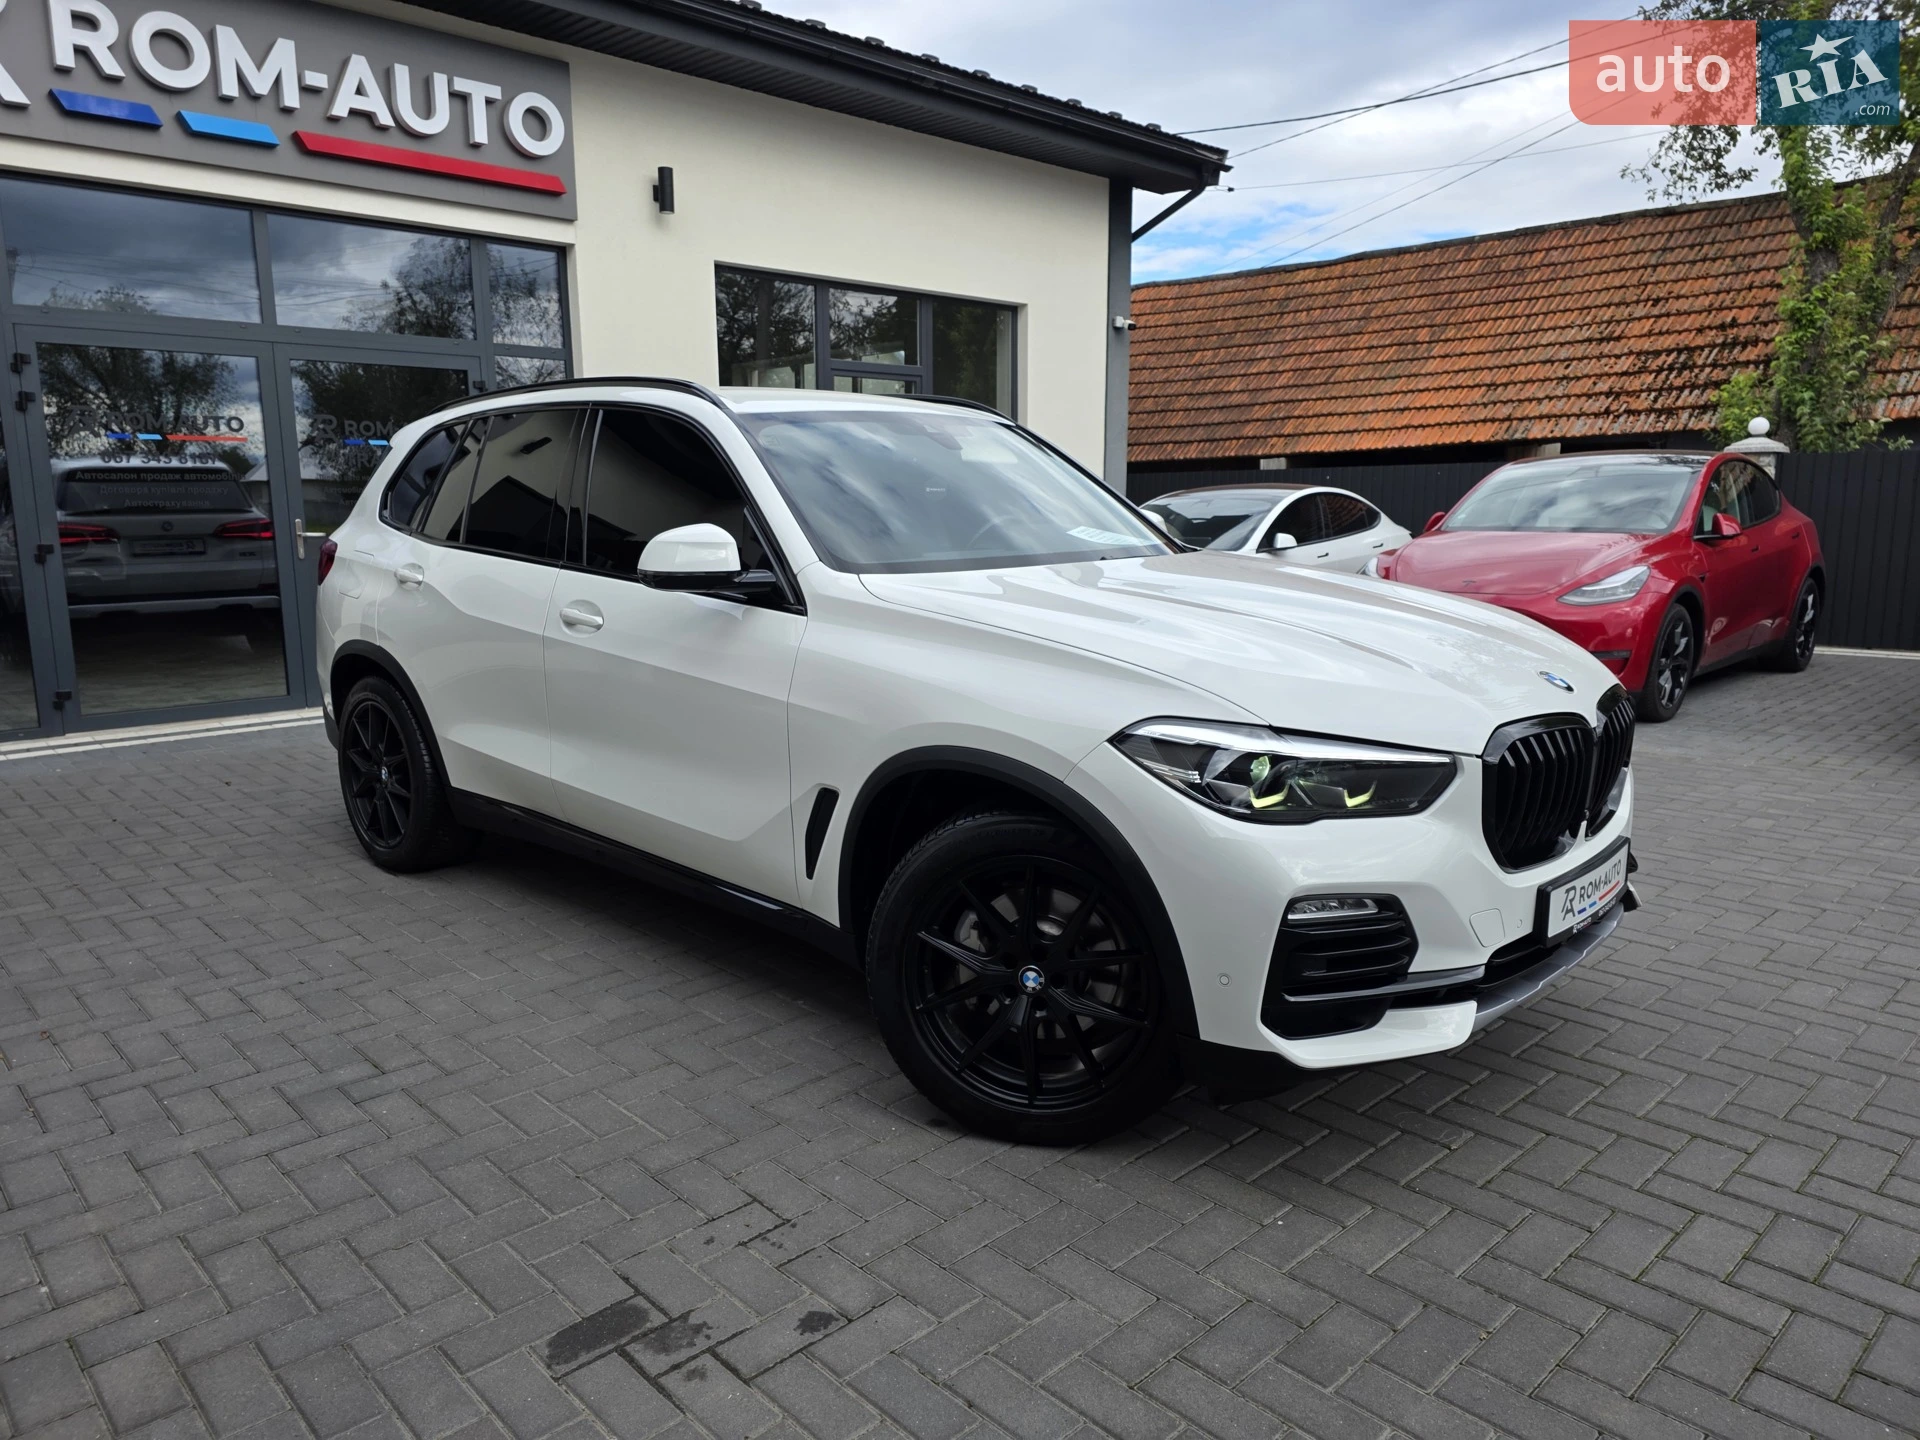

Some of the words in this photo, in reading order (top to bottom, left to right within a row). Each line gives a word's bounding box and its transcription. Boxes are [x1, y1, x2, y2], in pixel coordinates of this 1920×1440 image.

[48, 0, 566, 158] ROM-AUTO
[76, 471, 137, 480] Автосалон
[142, 472, 182, 482] продаж
[1578, 858, 1622, 905] ROM-AUTO
